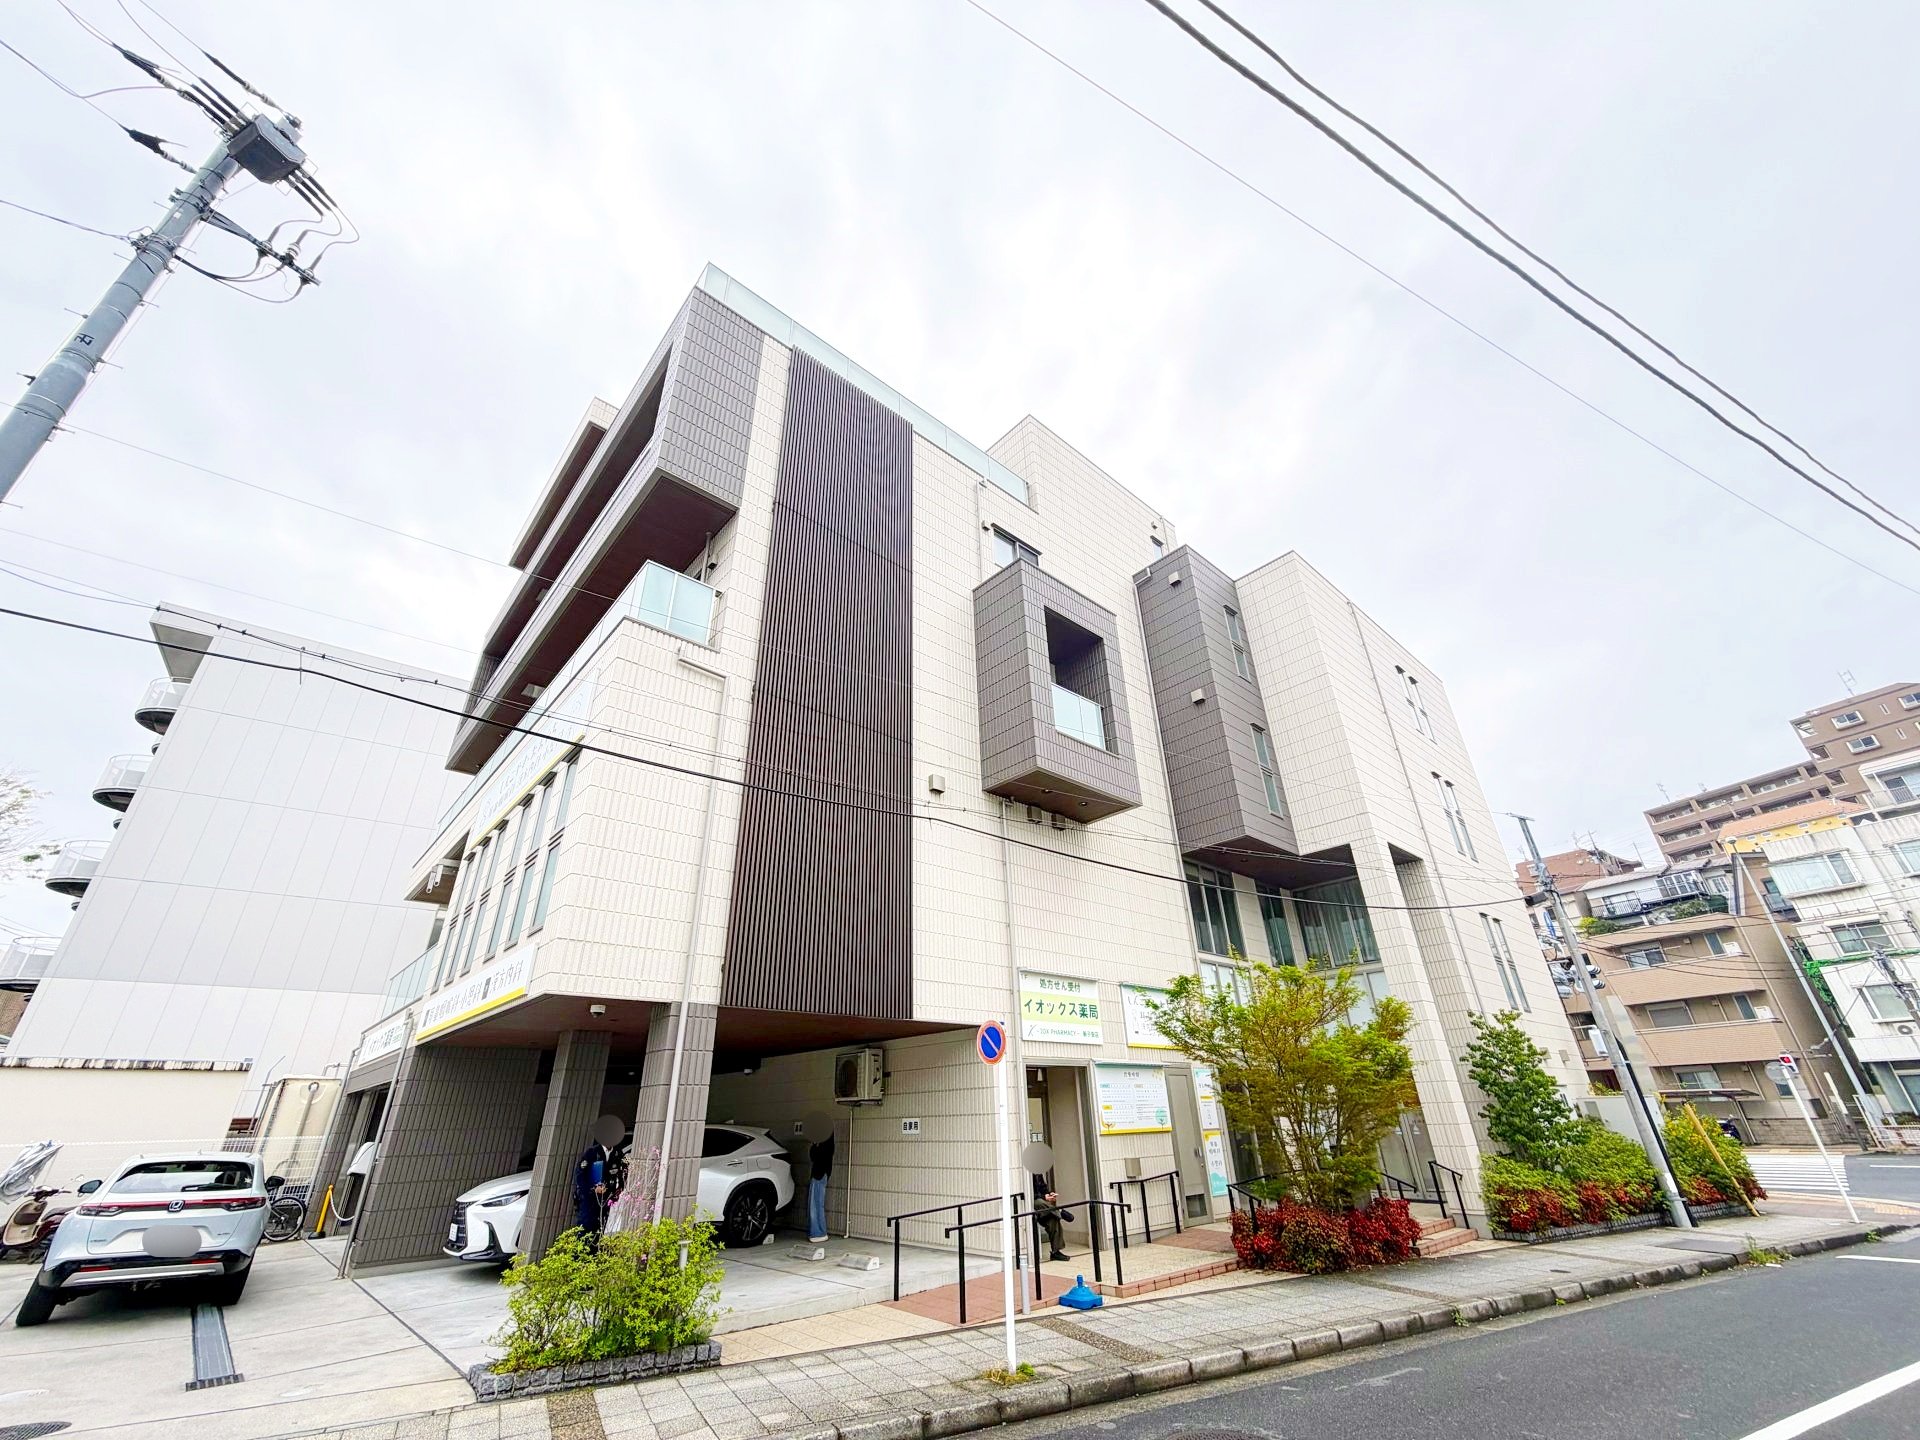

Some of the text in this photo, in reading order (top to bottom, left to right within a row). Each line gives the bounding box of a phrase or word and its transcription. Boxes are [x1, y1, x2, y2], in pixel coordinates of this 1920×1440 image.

[1039, 978, 1081, 993] 処方せん受付
[1024, 998, 1099, 1020] イオックス薬局
